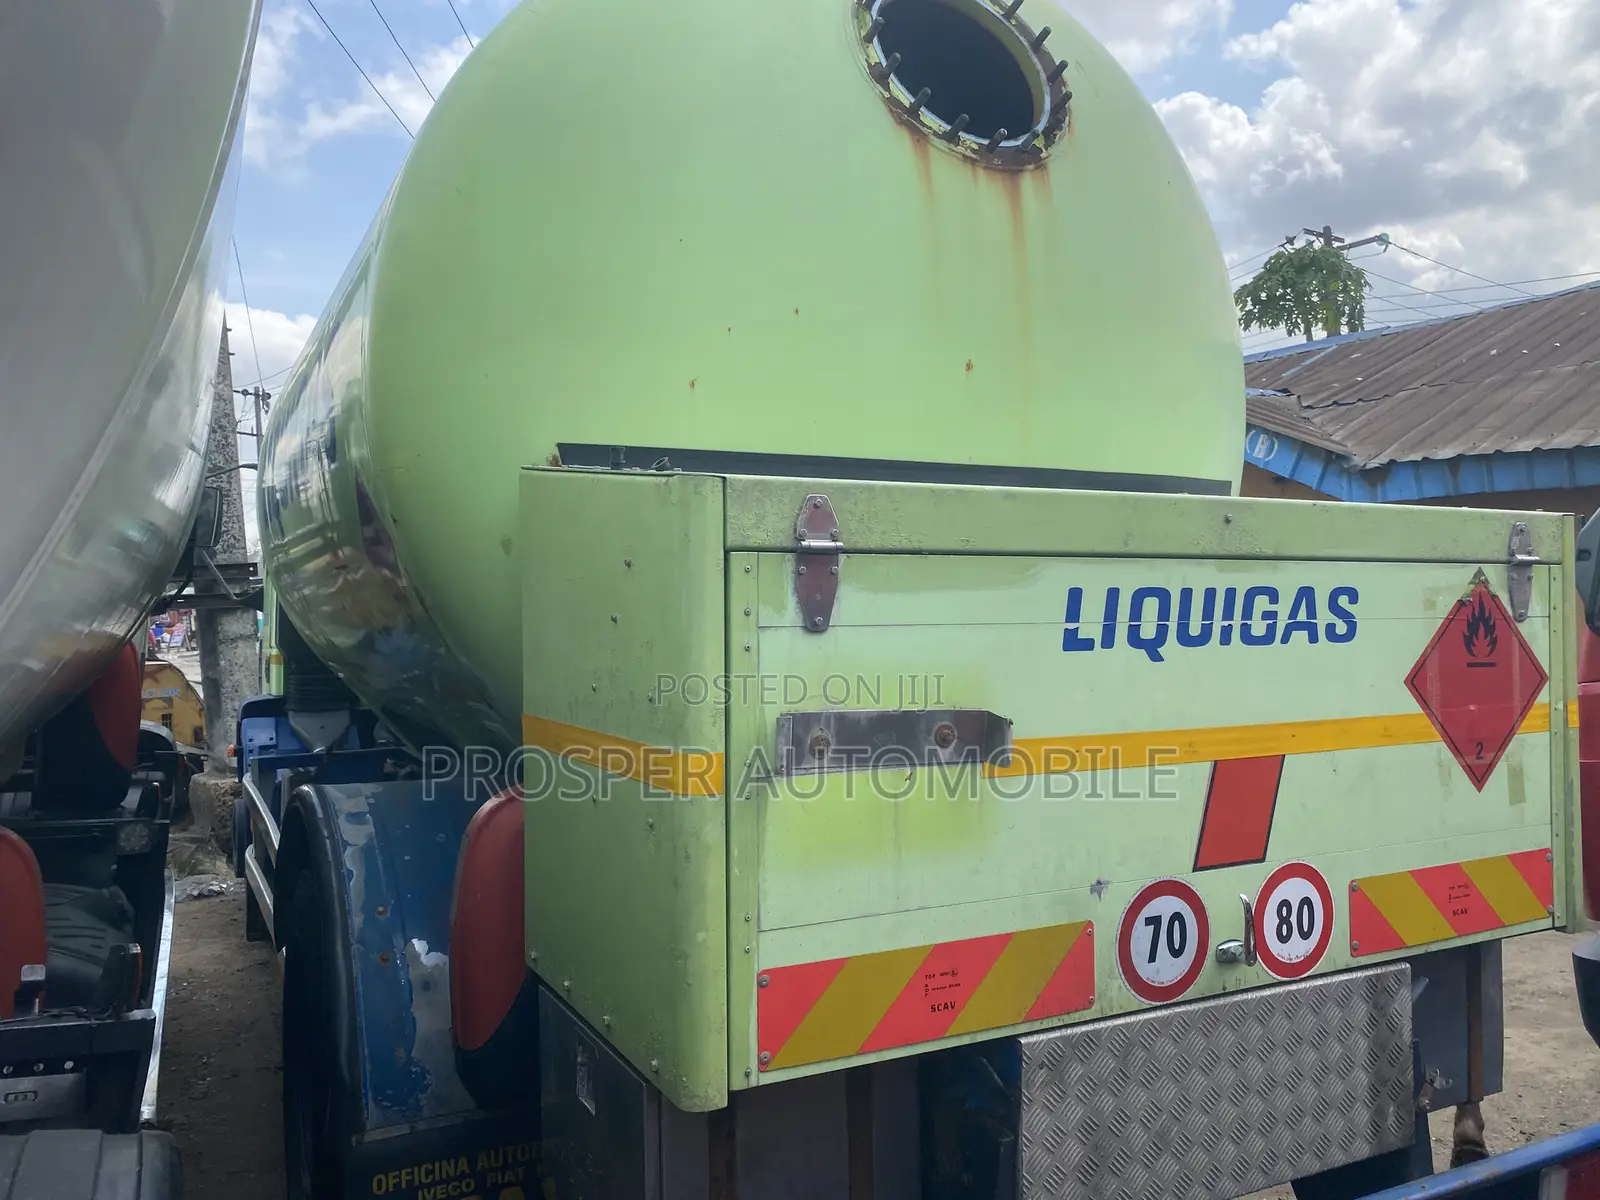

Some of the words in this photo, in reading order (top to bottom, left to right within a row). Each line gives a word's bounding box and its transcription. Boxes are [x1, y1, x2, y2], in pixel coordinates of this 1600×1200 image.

[1062, 586, 1359, 662] LIQUIGAS
[1475, 741, 1484, 760] 2
[1144, 911, 1187, 964] 70
[1275, 896, 1315, 944] 80
[930, 1000, 956, 1013] SCAV
[372, 1156, 470, 1195] OFFICINA
[417, 1177, 476, 1200] IVECO
[486, 1166, 527, 1188] FIAT
